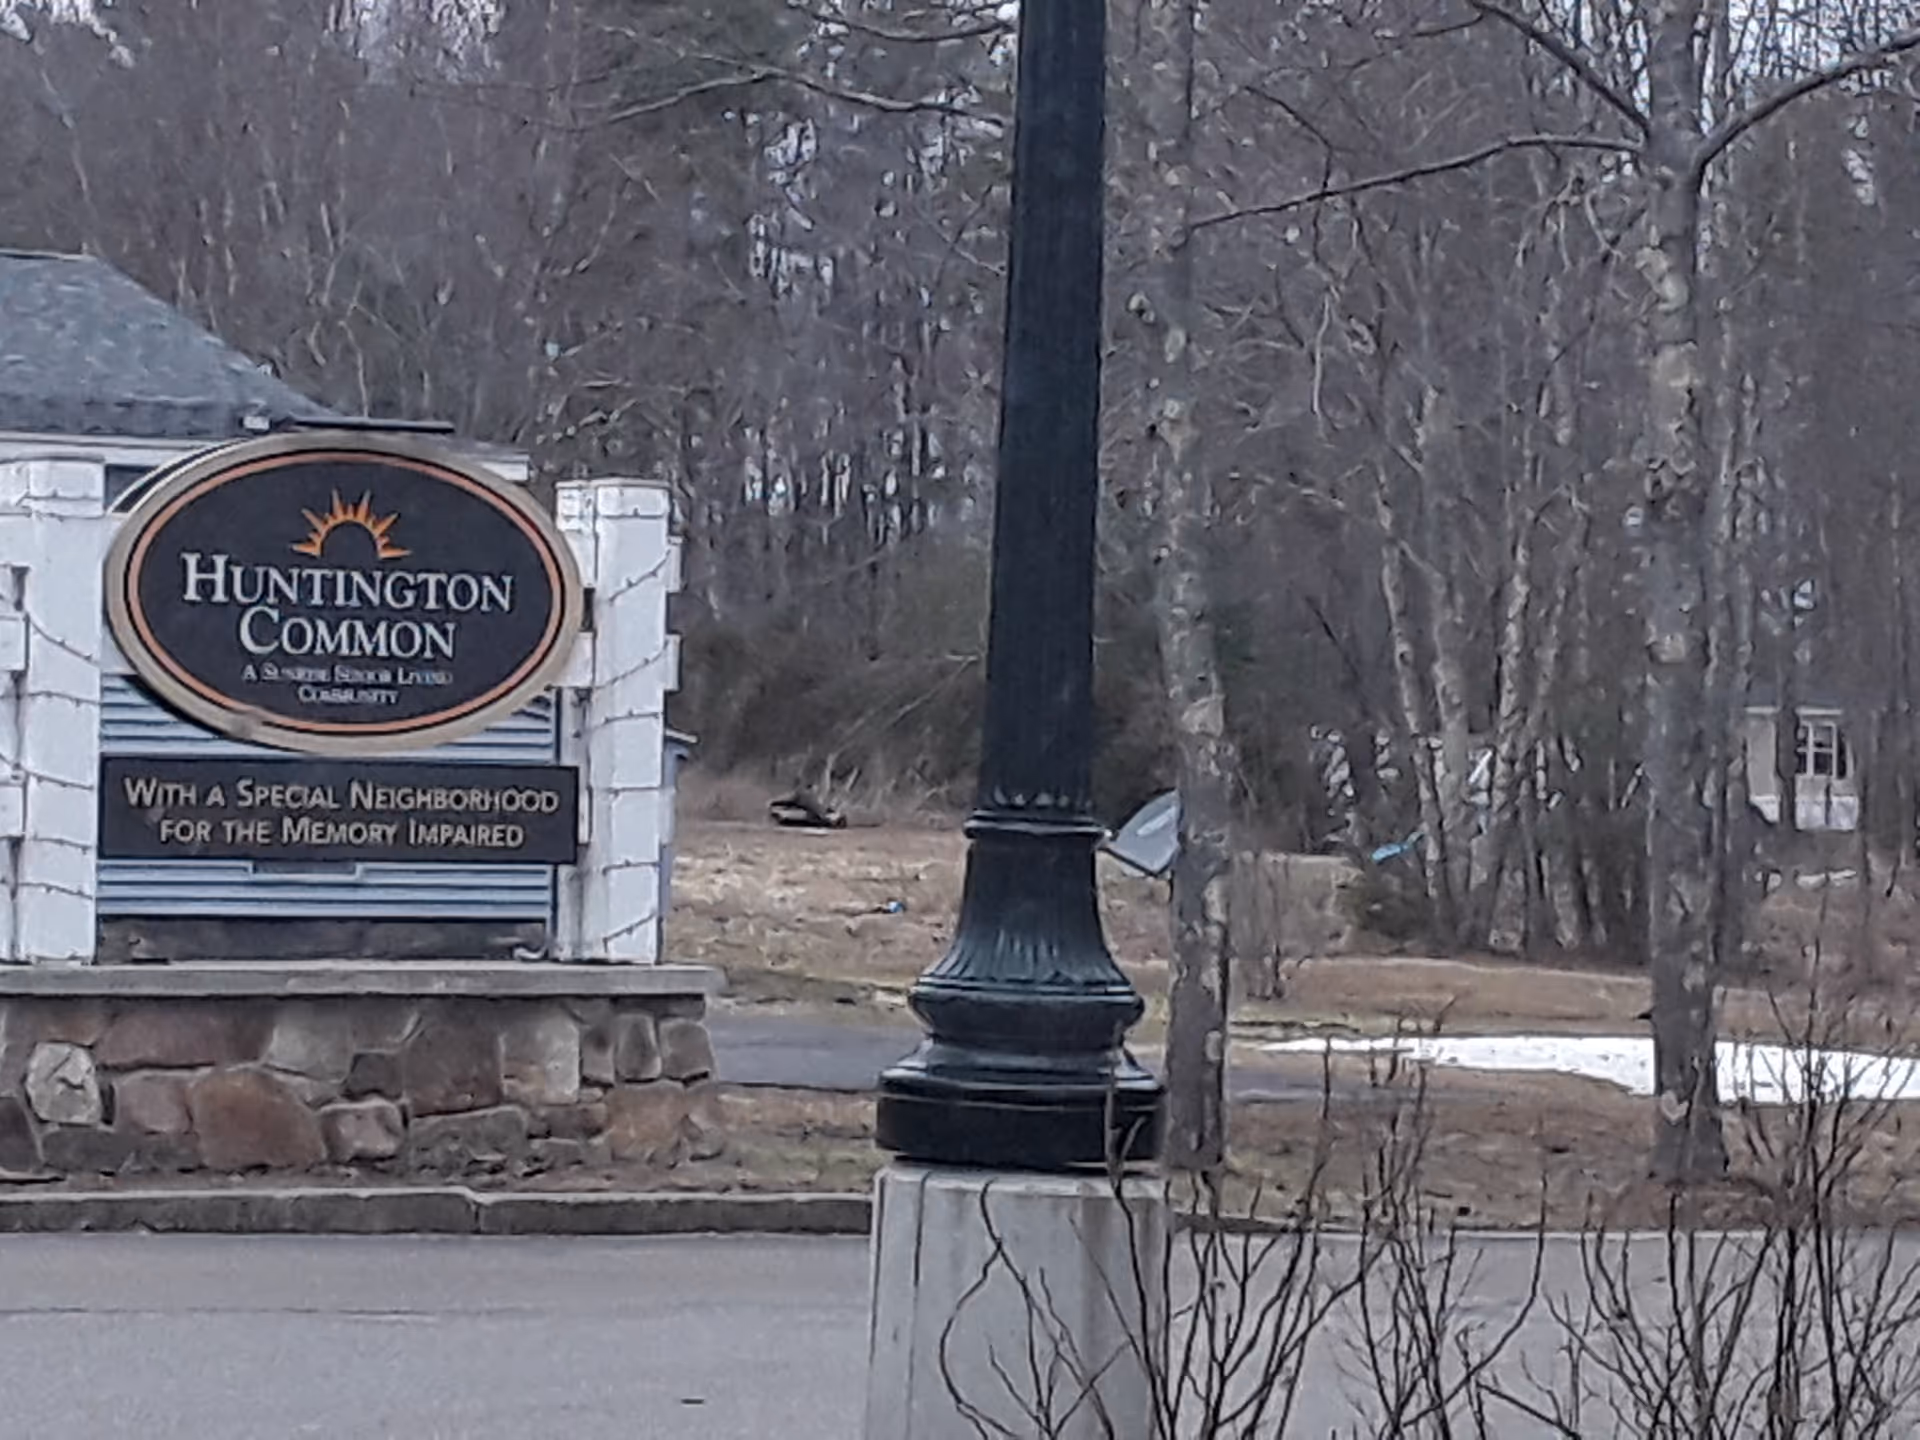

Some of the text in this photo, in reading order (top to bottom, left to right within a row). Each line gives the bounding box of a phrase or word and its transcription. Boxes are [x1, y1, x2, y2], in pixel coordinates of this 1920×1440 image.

[181, 552, 512, 612] HUNTINGTON
[239, 607, 455, 659] COMMON
[241, 664, 257, 680] A
[124, 778, 558, 812] WITH A SPECIAL NEIGHBORHOOD
[159, 817, 524, 846] FOR THE MEMORY IMPAIRED
